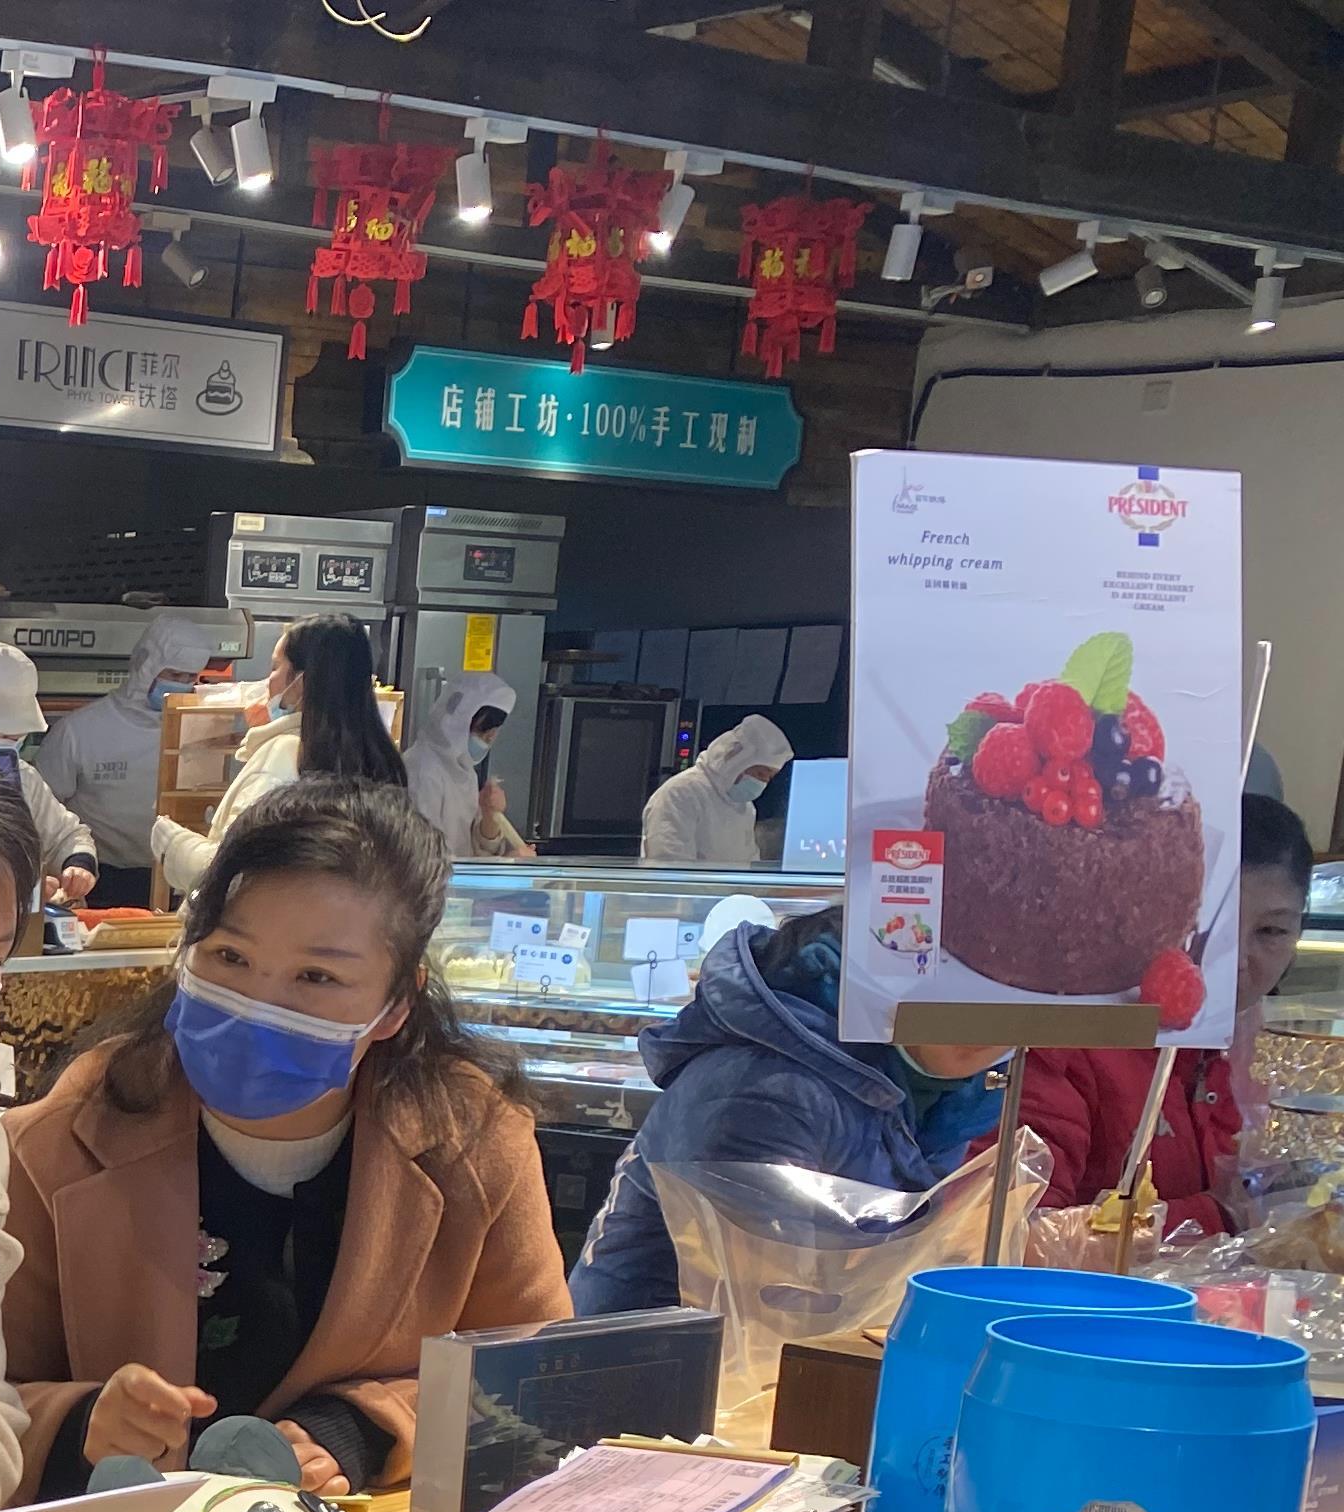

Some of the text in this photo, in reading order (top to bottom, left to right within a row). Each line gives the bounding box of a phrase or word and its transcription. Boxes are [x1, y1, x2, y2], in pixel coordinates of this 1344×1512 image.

[18, 339, 135, 392] FRANCE
[140, 352, 181, 379] 菲尔
[139, 383, 178, 410] 铁塔
[1108, 495, 1189, 518] PRÉSIDENT
[921, 530, 970, 545] French
[888, 553, 1003, 571] whipping cream
[13, 628, 96, 649] COMPO
